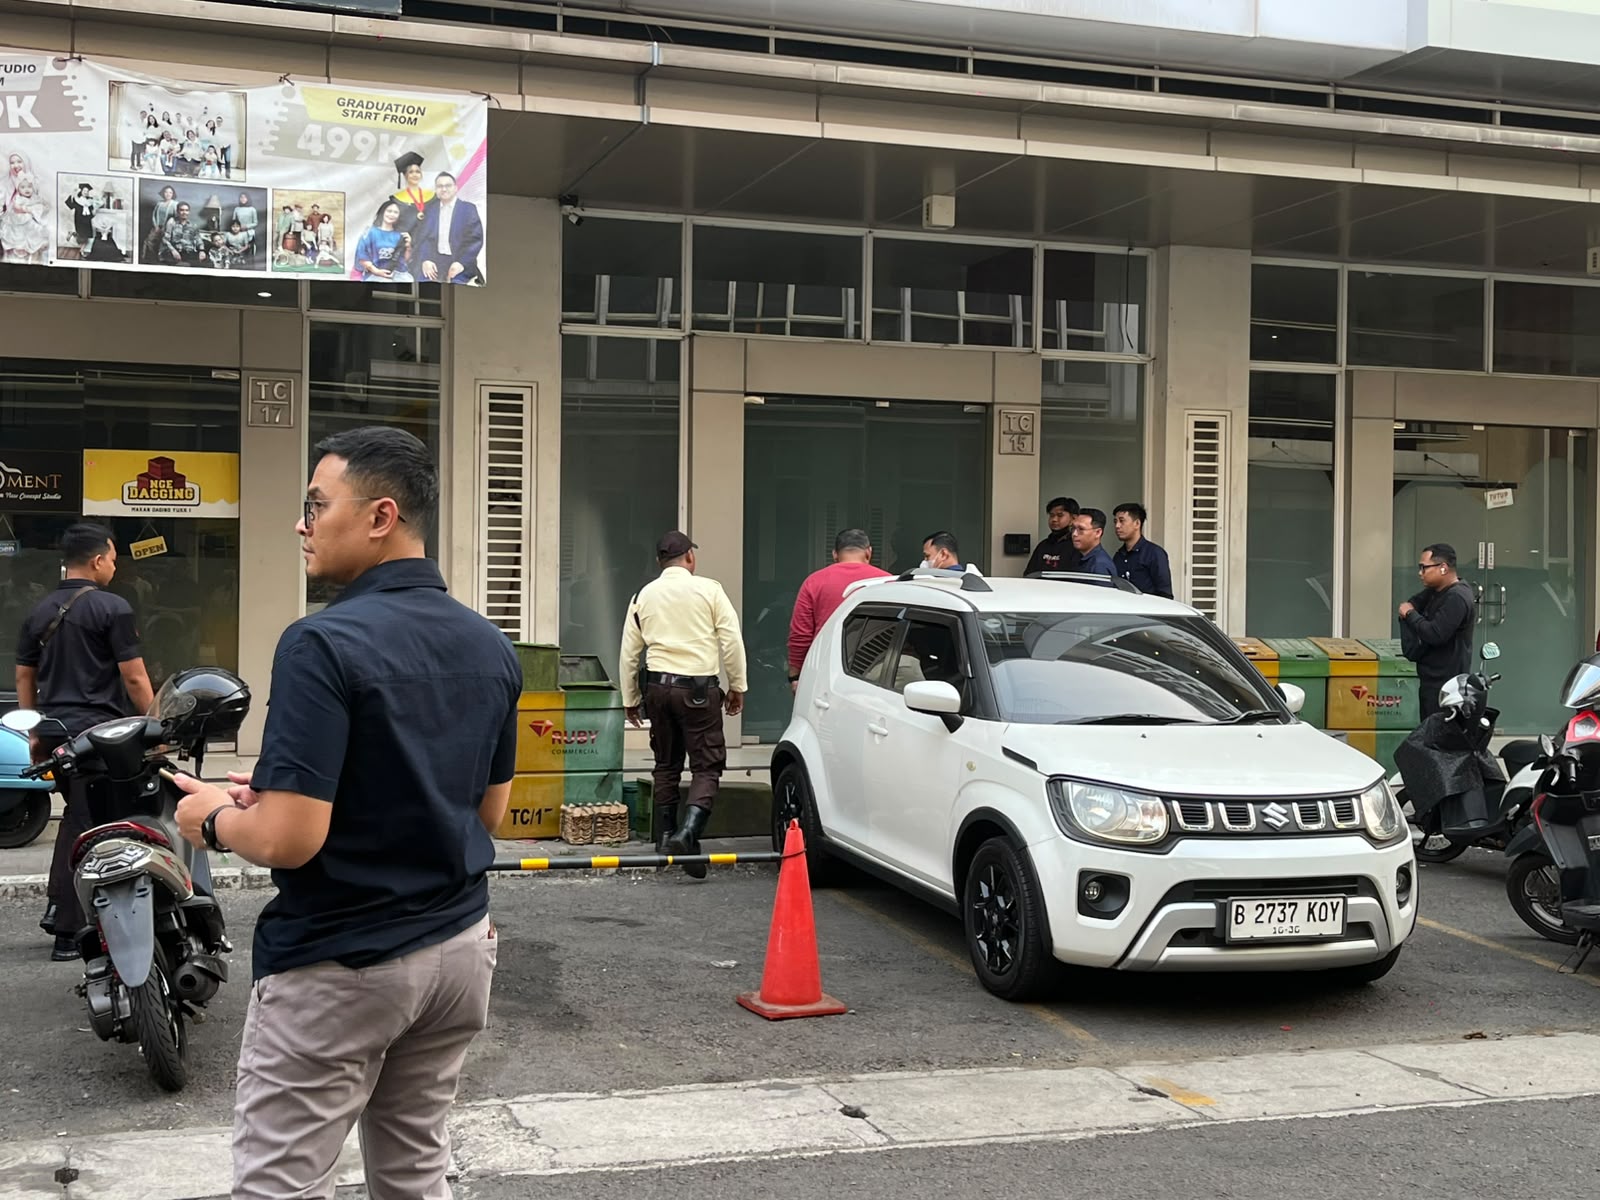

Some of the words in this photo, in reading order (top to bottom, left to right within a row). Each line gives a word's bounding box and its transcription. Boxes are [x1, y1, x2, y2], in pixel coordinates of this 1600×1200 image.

[336, 97, 426, 116] GRADUATION
[341, 108, 380, 121] START
[382, 115, 418, 126] FROM
[297, 123, 407, 163] 499K
[256, 381, 287, 400] TC
[261, 406, 282, 423] 17
[1005, 414, 1030, 431] TC
[1009, 434, 1026, 452] 15
[0, 470, 62, 490] MENT
[150, 479, 173, 489] NGE
[128, 486, 194, 500] DAGGING
[134, 543, 165, 557] OPEN
[1367, 695, 1402, 708] RUBY
[551, 730, 600, 745] RUBY
[1234, 904, 1245, 925] B
[1254, 902, 1298, 924] 2737
[1306, 901, 1340, 923] KOY
